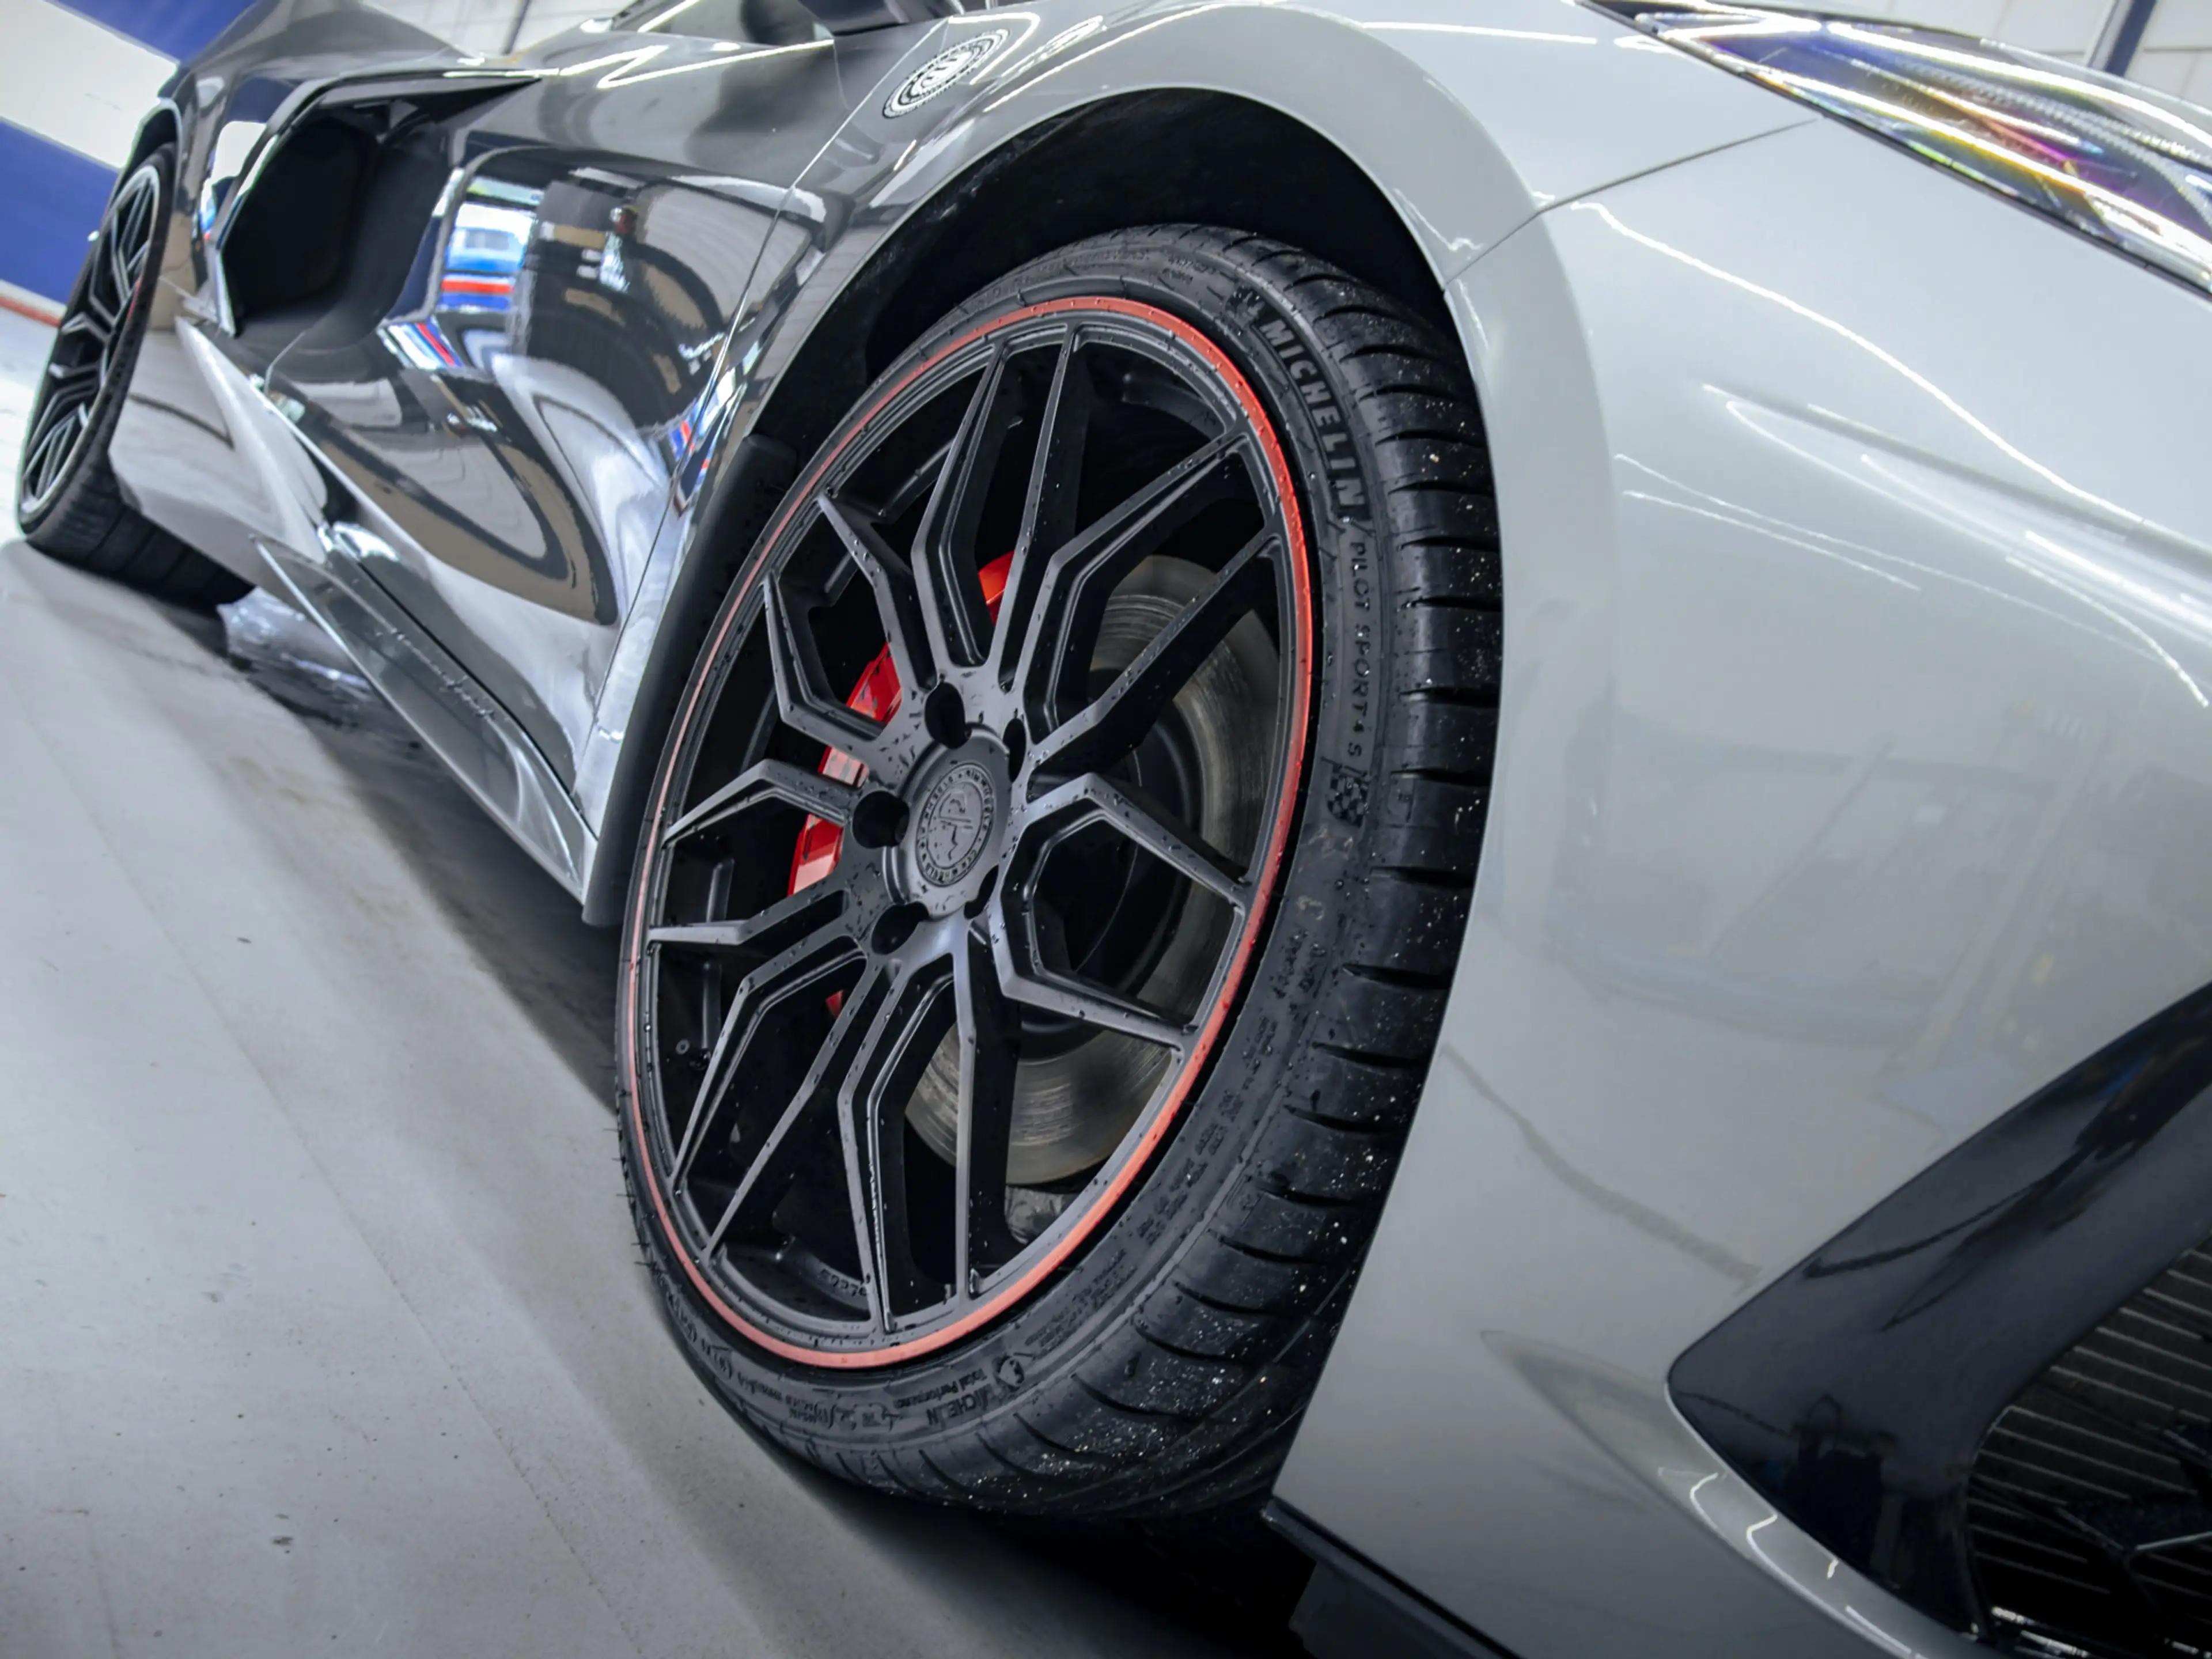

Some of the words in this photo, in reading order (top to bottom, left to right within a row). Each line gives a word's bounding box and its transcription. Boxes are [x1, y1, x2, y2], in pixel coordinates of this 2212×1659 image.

[1260, 319, 1365, 505] MICHELIN
[1349, 541, 1372, 612] PILOT
[1354, 624, 1372, 717] SPORT
[1346, 743, 1363, 757] S
